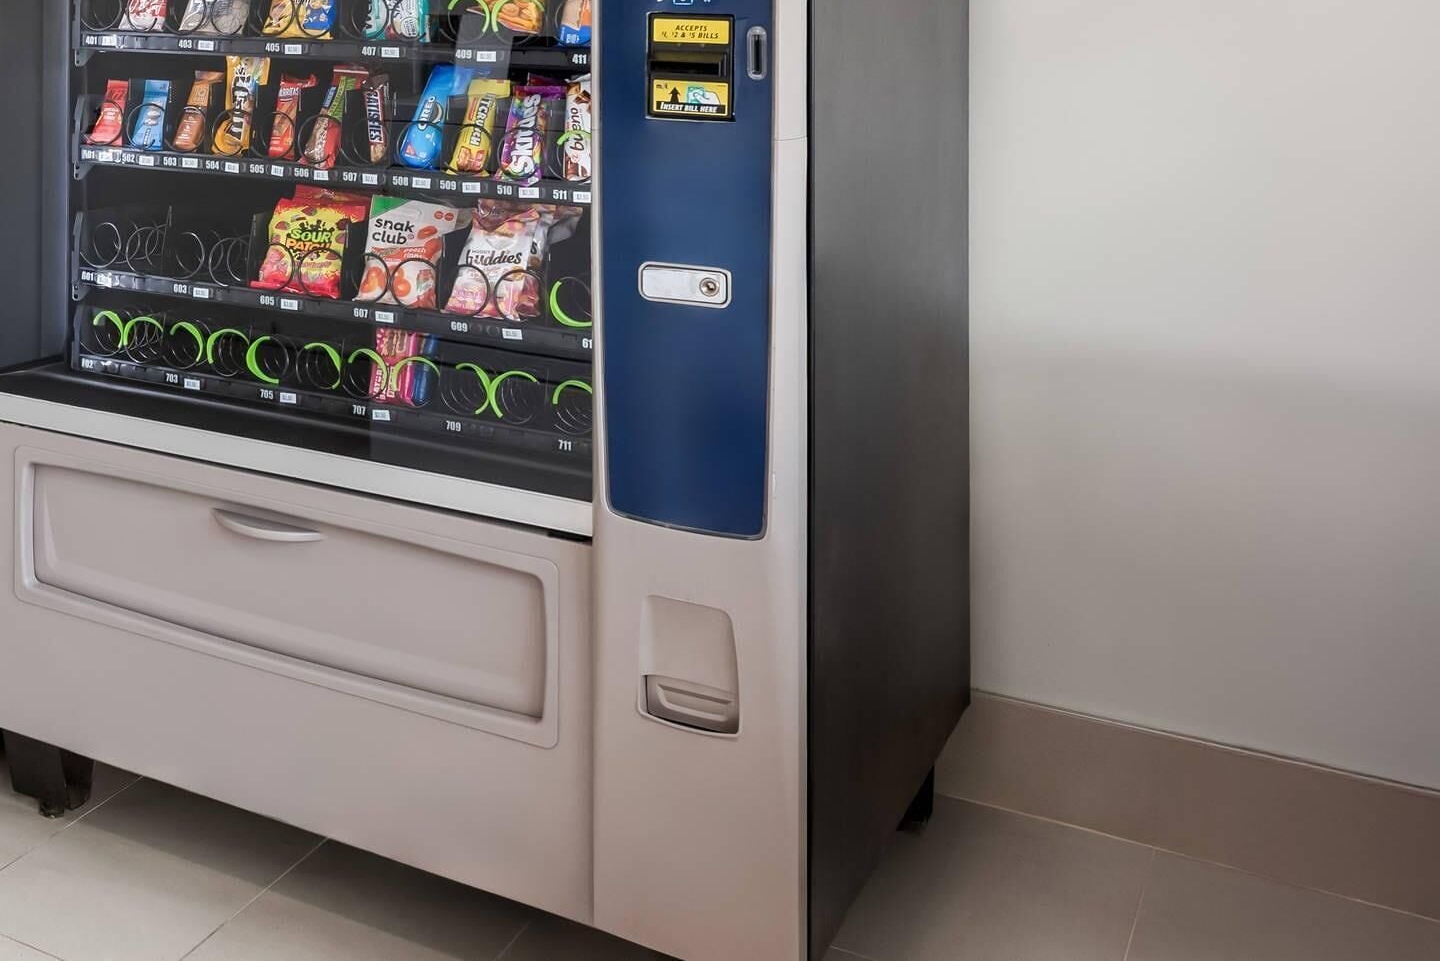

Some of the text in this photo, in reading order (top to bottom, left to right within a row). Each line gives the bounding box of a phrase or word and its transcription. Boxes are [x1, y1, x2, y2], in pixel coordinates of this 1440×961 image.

[675, 24, 708, 32] ACCEPTS
[85, 36, 97, 45] 401
[178, 39, 192, 48] 403
[265, 42, 280, 52] 405
[361, 46, 376, 56] 407
[455, 49, 472, 59] 409
[572, 53, 587, 65] 411
[660, 101, 718, 114] INSERT BILL HERE
[417, 96, 436, 131] OREO
[122, 154, 135, 164] 502
[163, 157, 177, 167] 503
[205, 160, 219, 170] 504
[249, 164, 264, 174] 505
[294, 168, 309, 178] 506
[342, 171, 358, 182] 507
[392, 175, 409, 186] 508
[439, 180, 457, 191] 509
[497, 184, 512, 195] 510
[553, 189, 567, 200] 511
[374, 218, 415, 233] snak
[291, 227, 332, 243] SOUR
[372, 230, 407, 245] club
[466, 249, 522, 266] buddies
[173, 283, 187, 294] 603
[260, 295, 275, 306] 605
[353, 308, 368, 319] 607
[450, 321, 468, 333] 609
[166, 373, 178, 384] 703
[260, 389, 274, 400] 705
[352, 405, 366, 416] 707
[446, 420, 462, 432] 709
[558, 440, 572, 452] 711
